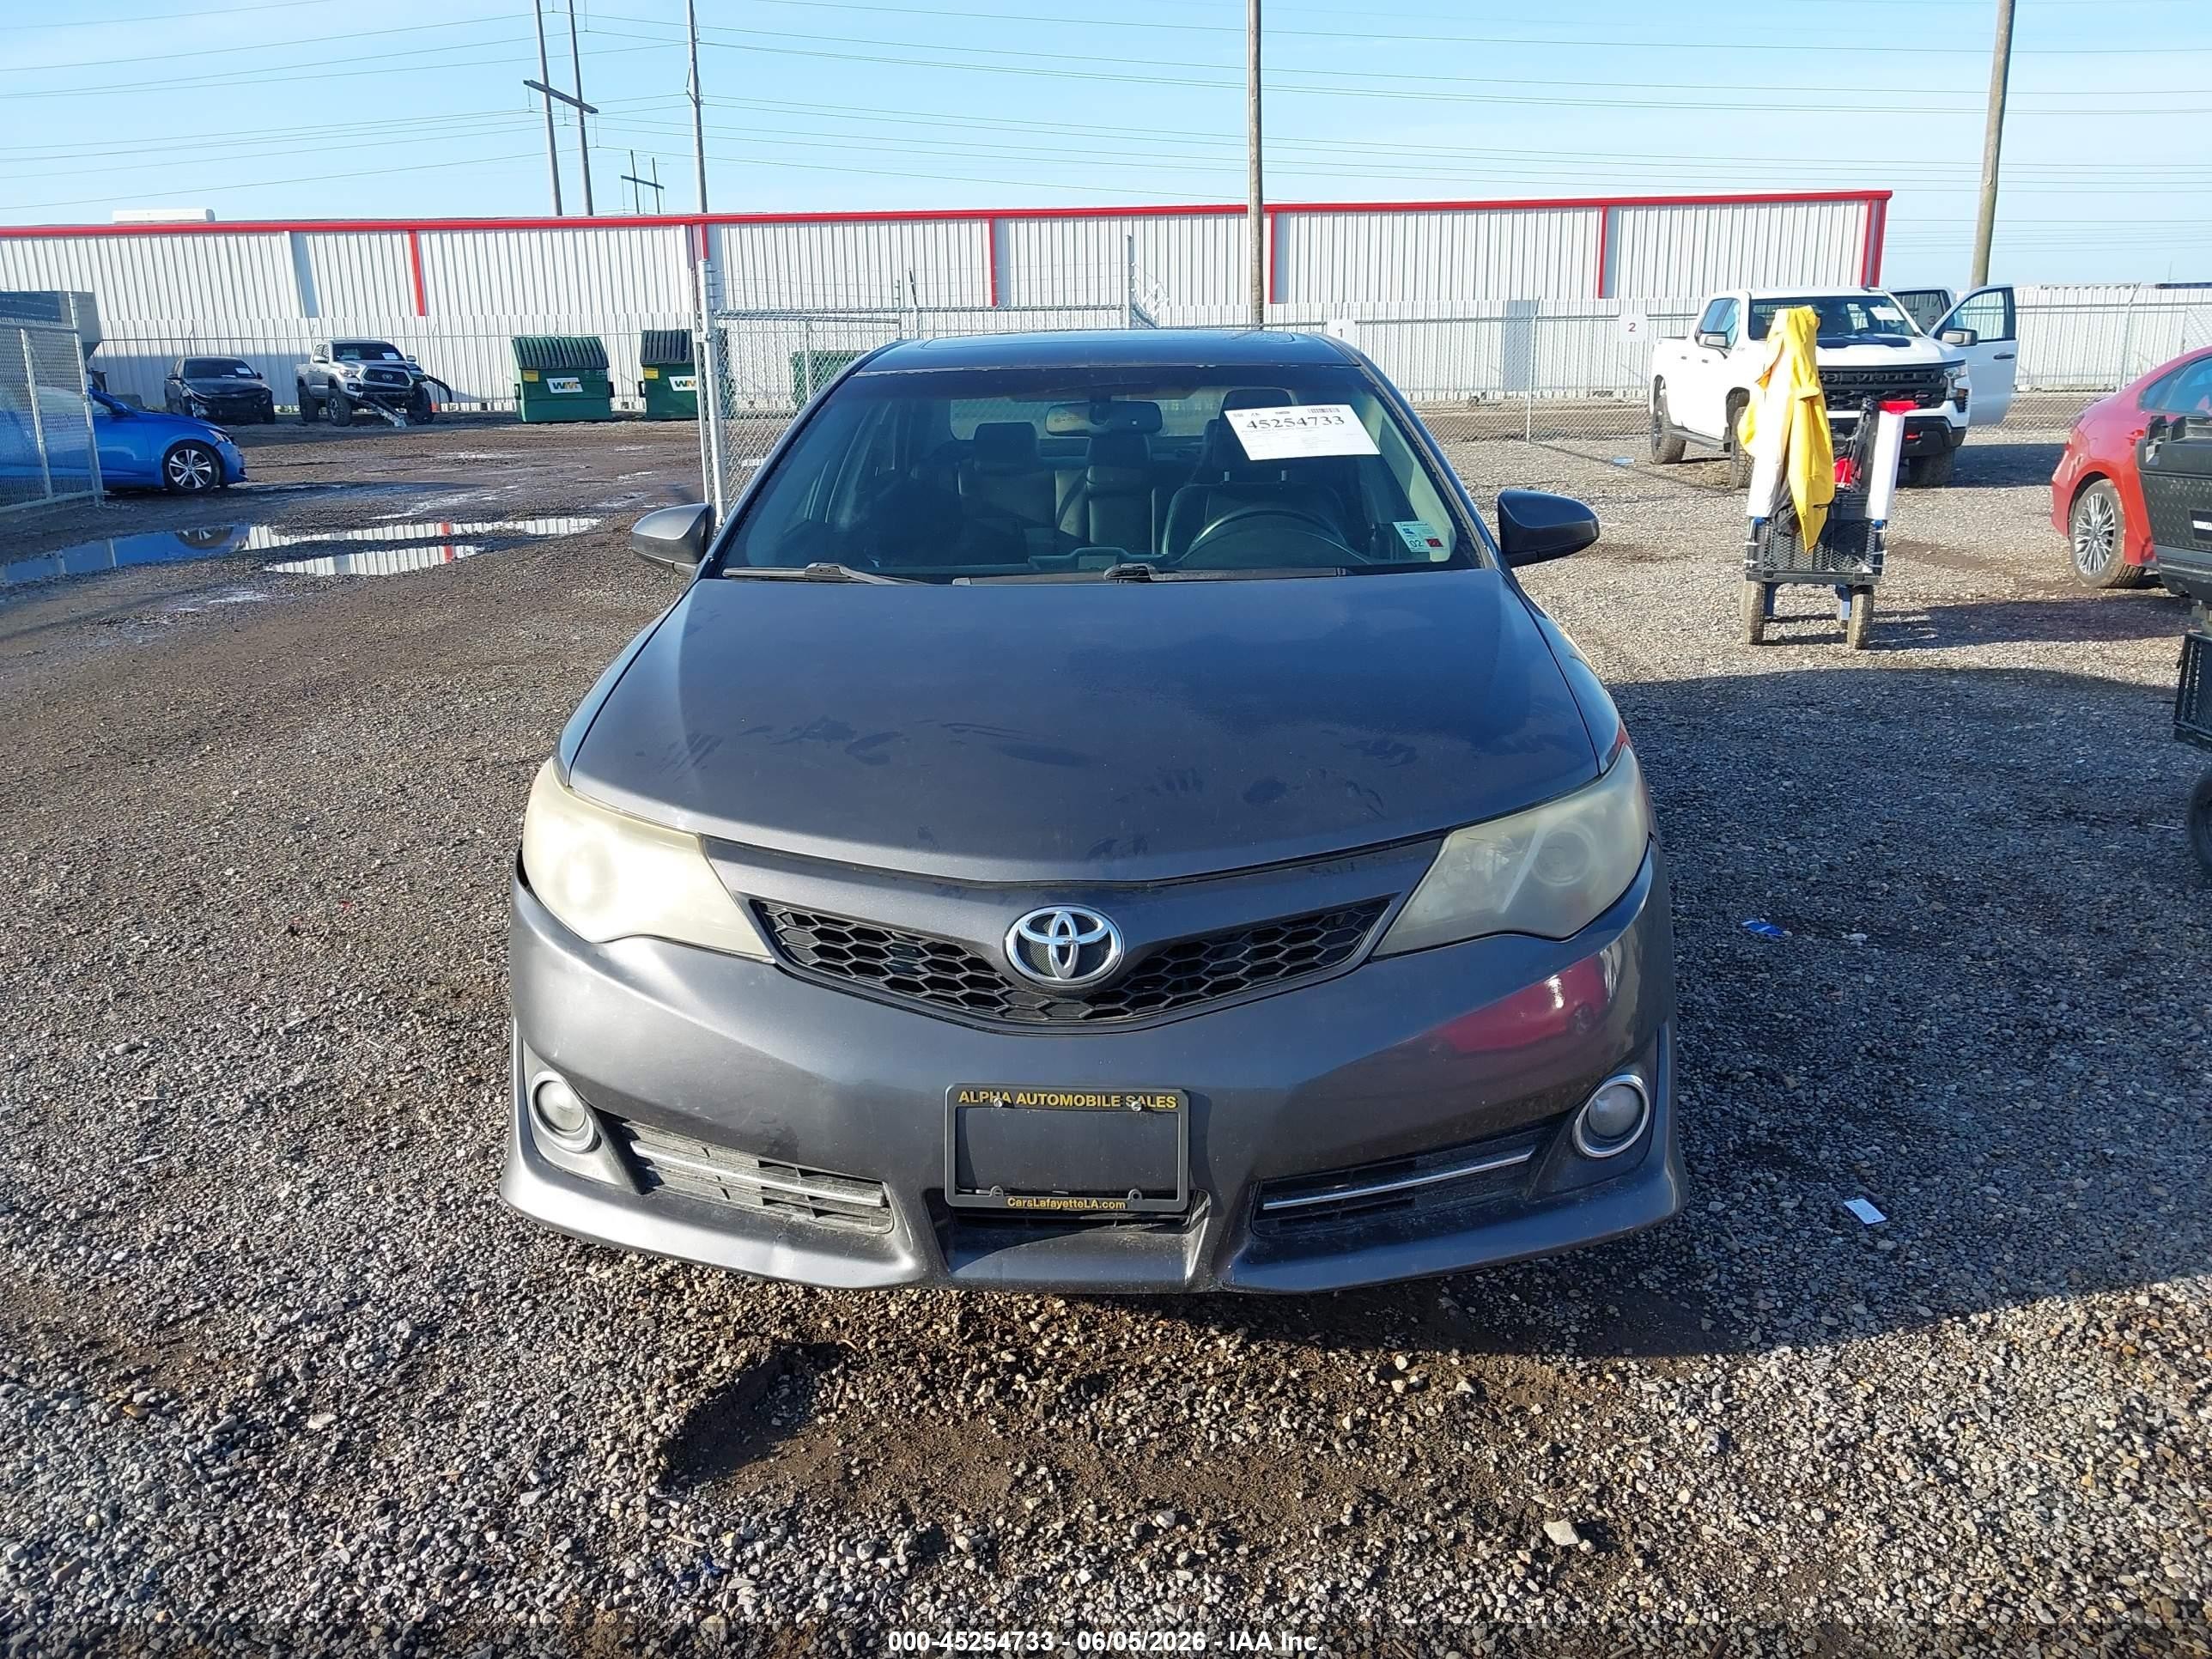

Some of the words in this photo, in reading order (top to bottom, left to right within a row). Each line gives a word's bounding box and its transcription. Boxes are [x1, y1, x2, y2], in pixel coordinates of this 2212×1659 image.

[1338, 328, 1343, 337] 1
[1628, 322, 1636, 332] 2
[1819, 371, 1942, 384] HEVROLET
[552, 381, 578, 390] WM
[1246, 416, 1345, 429] 45254733
[957, 1091, 1012, 1104] ALPHA
[1016, 1091, 1121, 1108] AUTOMOBILE
[1125, 1095, 1179, 1109] SALES
[1007, 1197, 1126, 1210] CarsLafayetteLA.com
